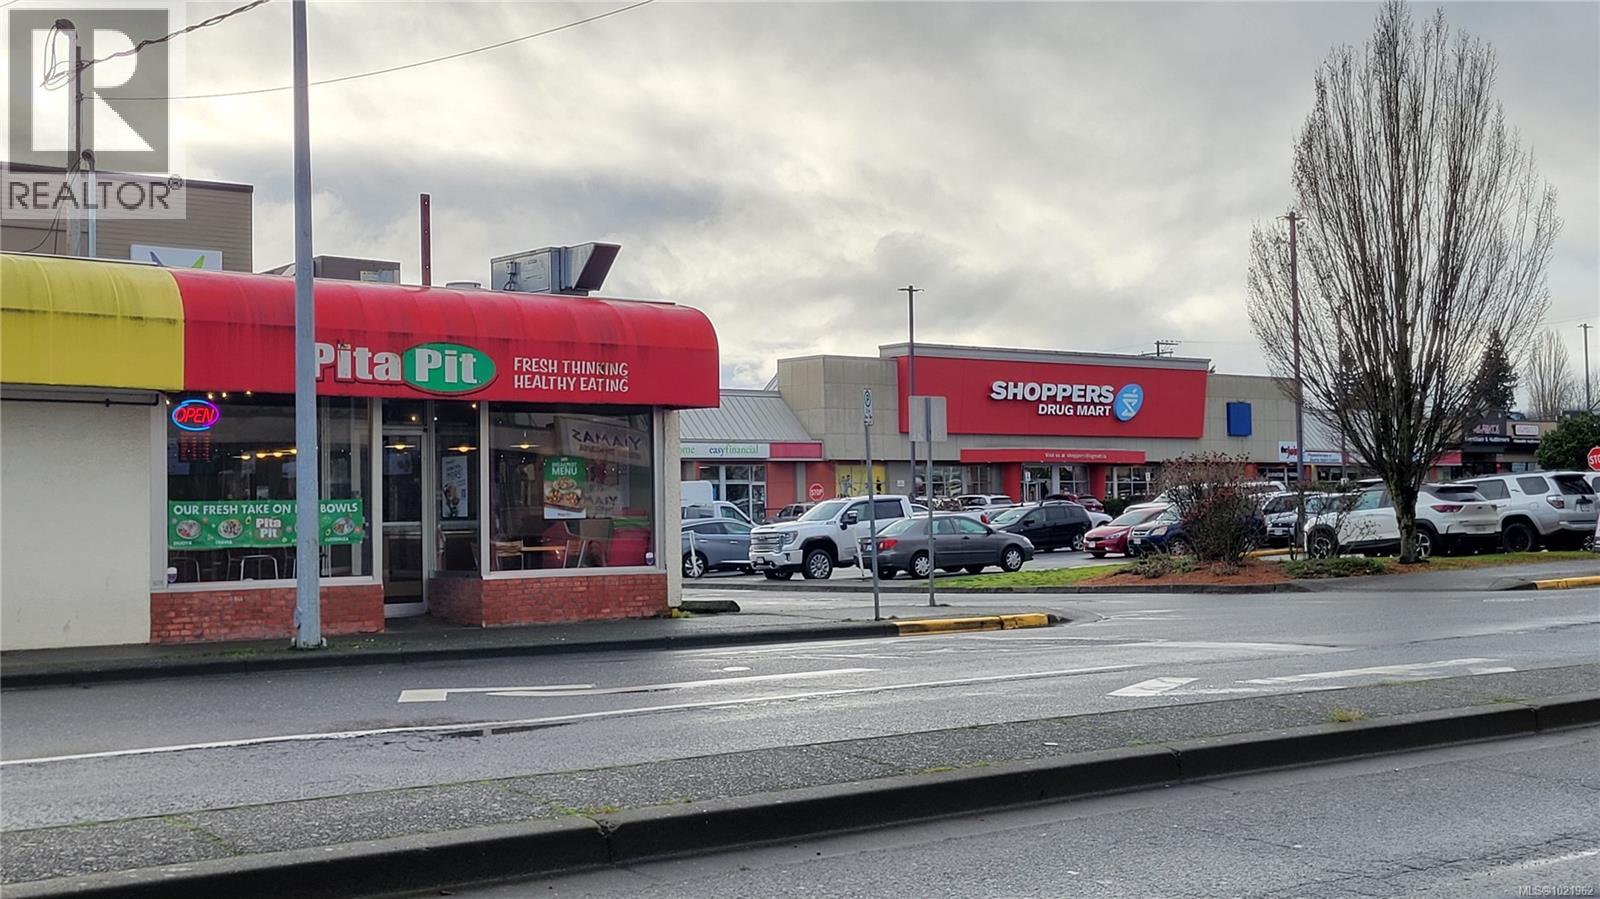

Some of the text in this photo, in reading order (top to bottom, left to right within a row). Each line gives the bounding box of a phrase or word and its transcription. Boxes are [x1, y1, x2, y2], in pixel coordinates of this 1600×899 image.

[314, 342, 478, 384] Pita Pit
[514, 357, 629, 376] FRESH THINKING
[514, 374, 629, 393] HEALTHY EATING
[990, 380, 1115, 404] SHOPPERS
[175, 407, 215, 424] OPEN
[1038, 403, 1112, 417] DRUG MART
[709, 445, 759, 456] easyfinancial
[1589, 454, 1600, 465] STO
[551, 466, 578, 476] MENU
[810, 488, 824, 497] STOP
[173, 504, 200, 515] OUR
[203, 504, 238, 515] FRESH
[241, 503, 269, 514] TAKE
[272, 503, 291, 514] ON
[320, 502, 358, 513] BOWLS
[255, 518, 282, 528] Pita
[260, 528, 278, 538] Pit
